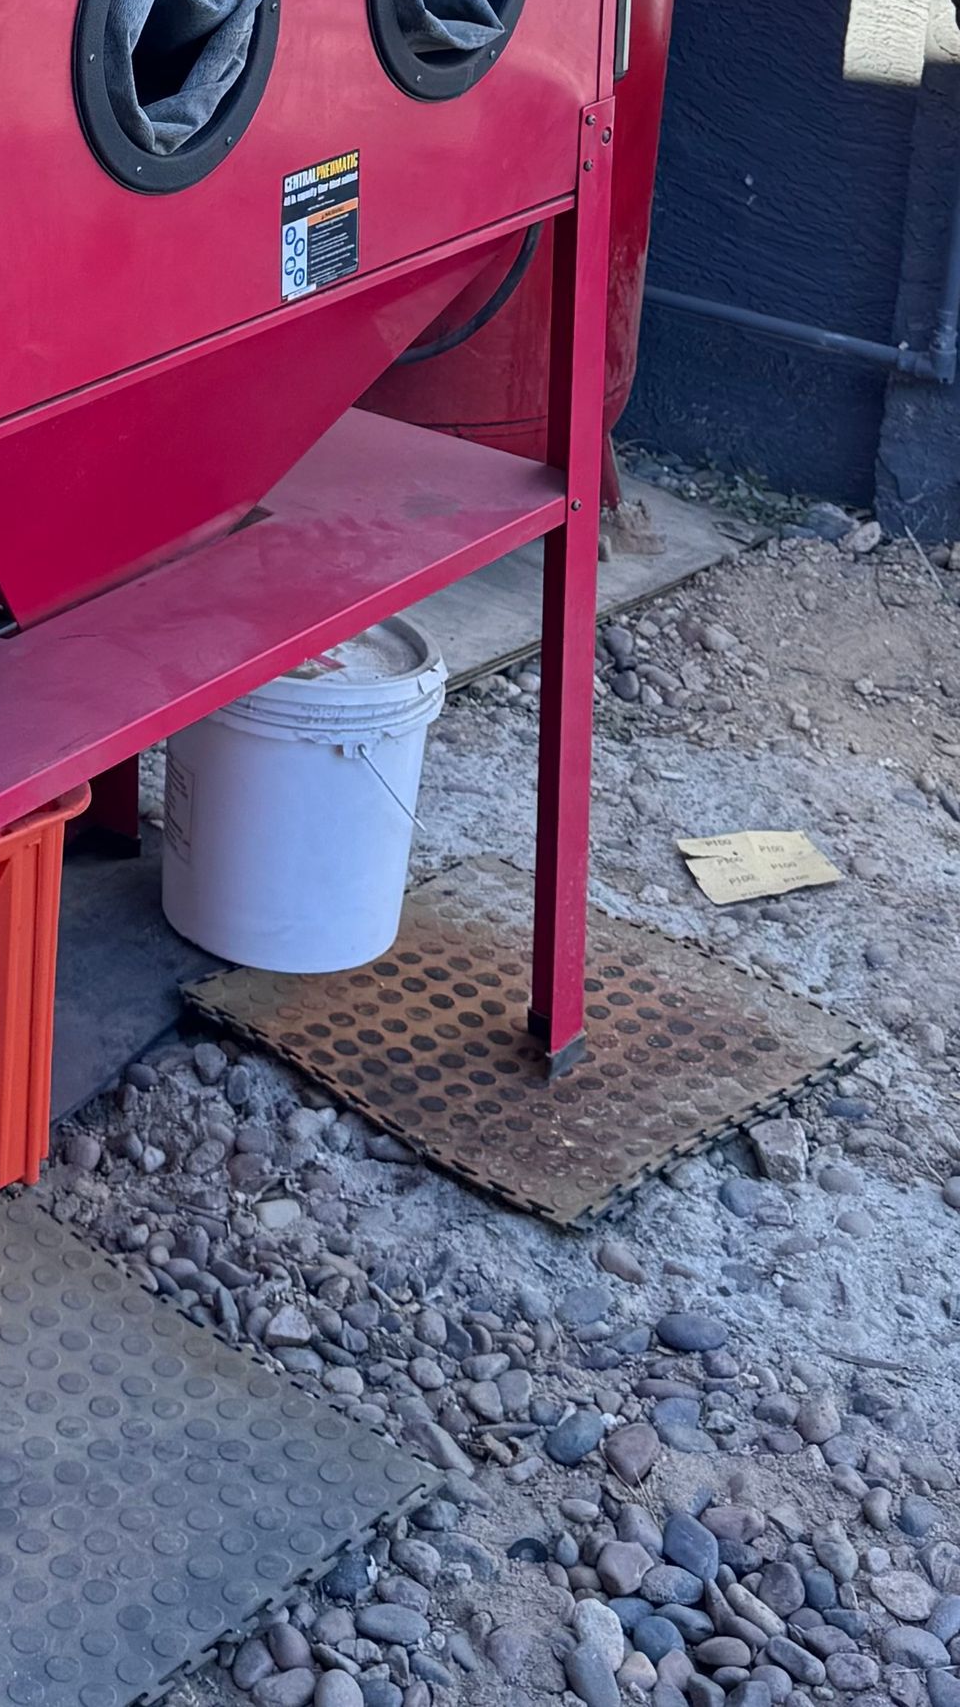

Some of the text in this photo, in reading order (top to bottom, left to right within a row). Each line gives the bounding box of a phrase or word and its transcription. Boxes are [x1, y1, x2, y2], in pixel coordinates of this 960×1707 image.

[704, 838, 732, 847] P100
[758, 844, 784, 853] P100
[728, 874, 756, 885] P100
